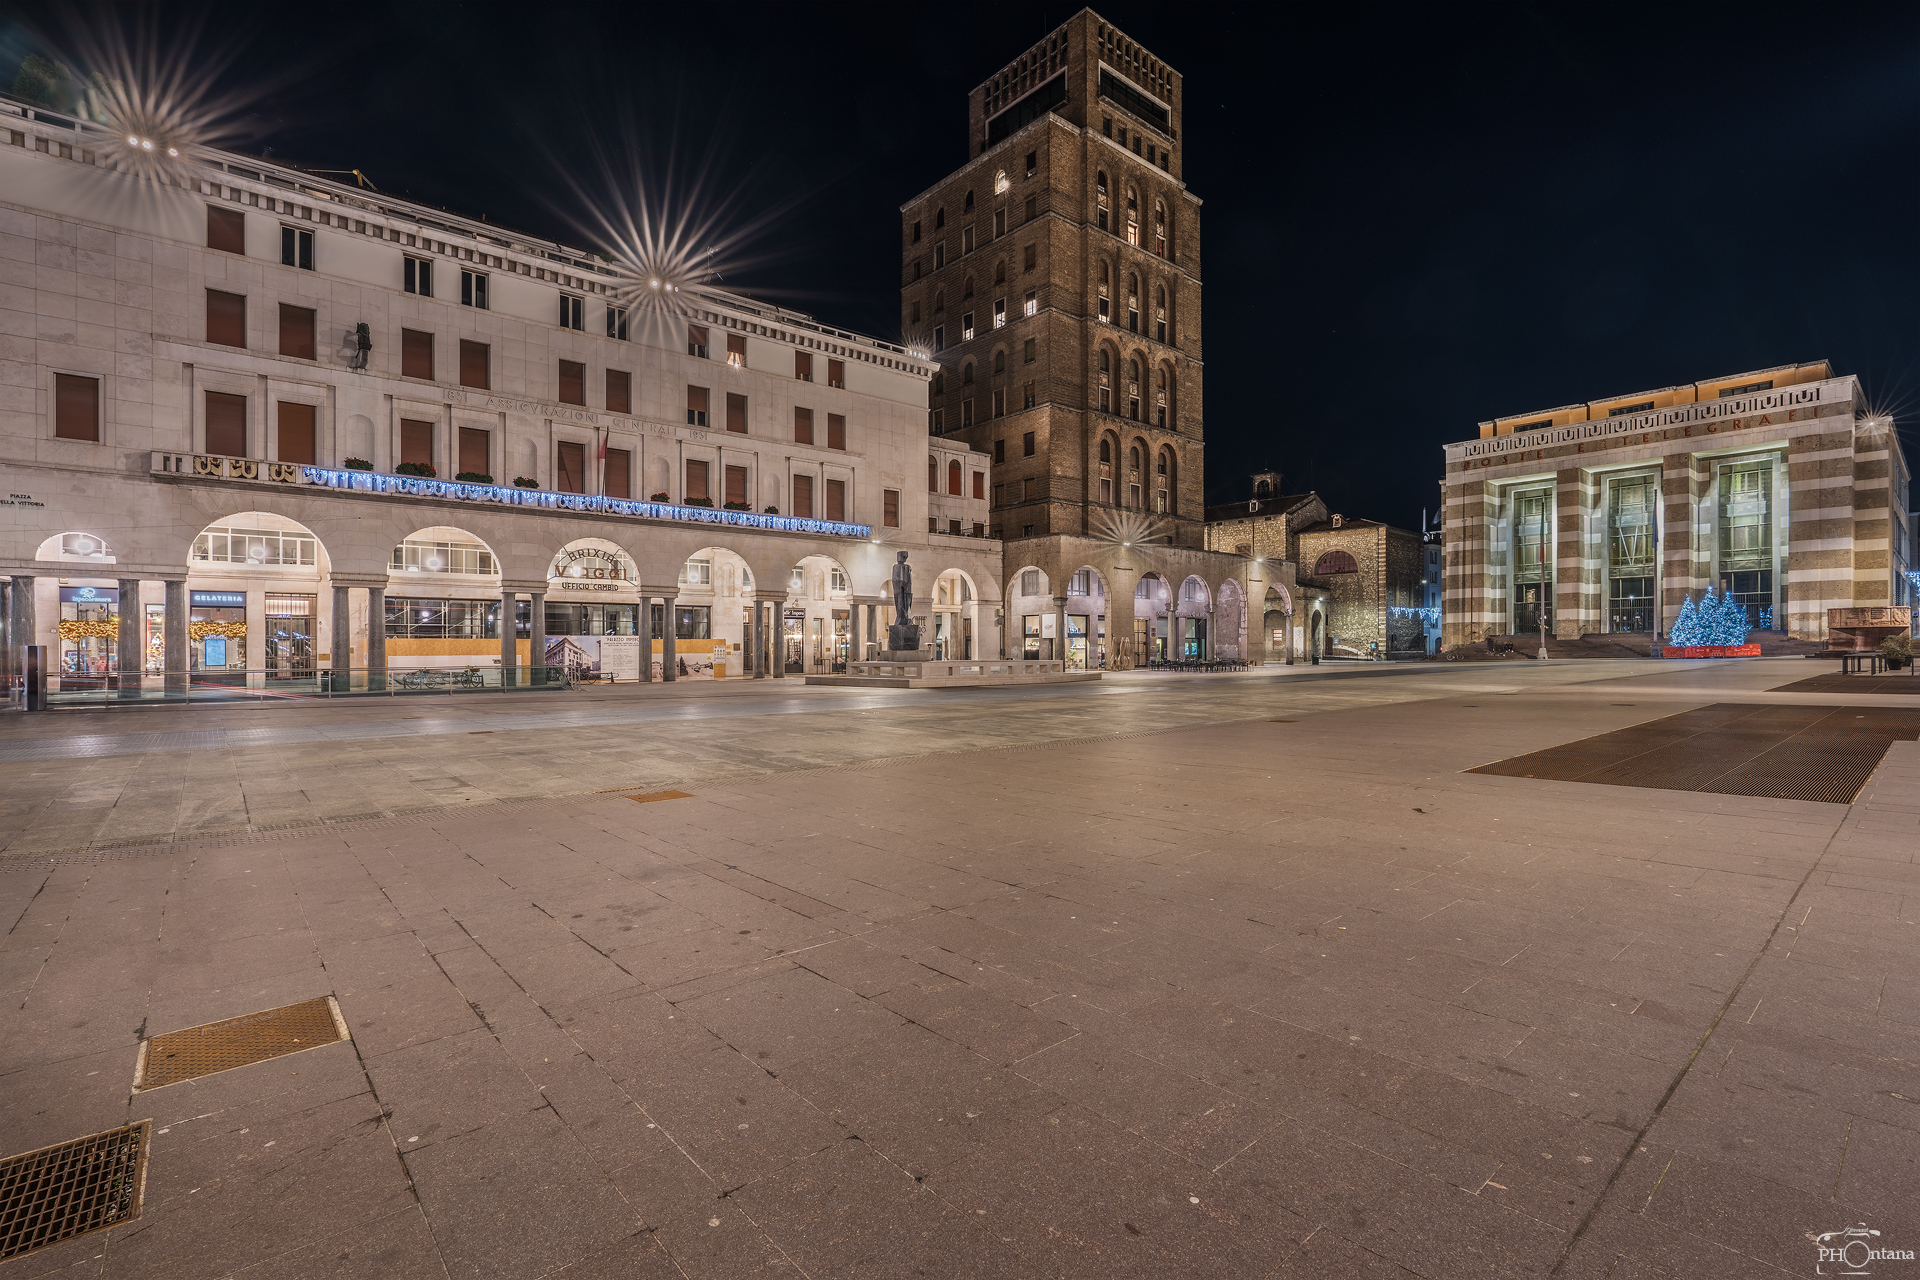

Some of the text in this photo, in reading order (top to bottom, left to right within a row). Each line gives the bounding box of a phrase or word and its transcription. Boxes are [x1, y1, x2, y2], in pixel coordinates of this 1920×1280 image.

[1465, 407, 1818, 470] POSTE E TELEGRAFI
[568, 548, 615, 563] BRIXIA
[556, 565, 626, 580] VAGGI
[562, 582, 618, 591] UFFICIO CAMBIO
